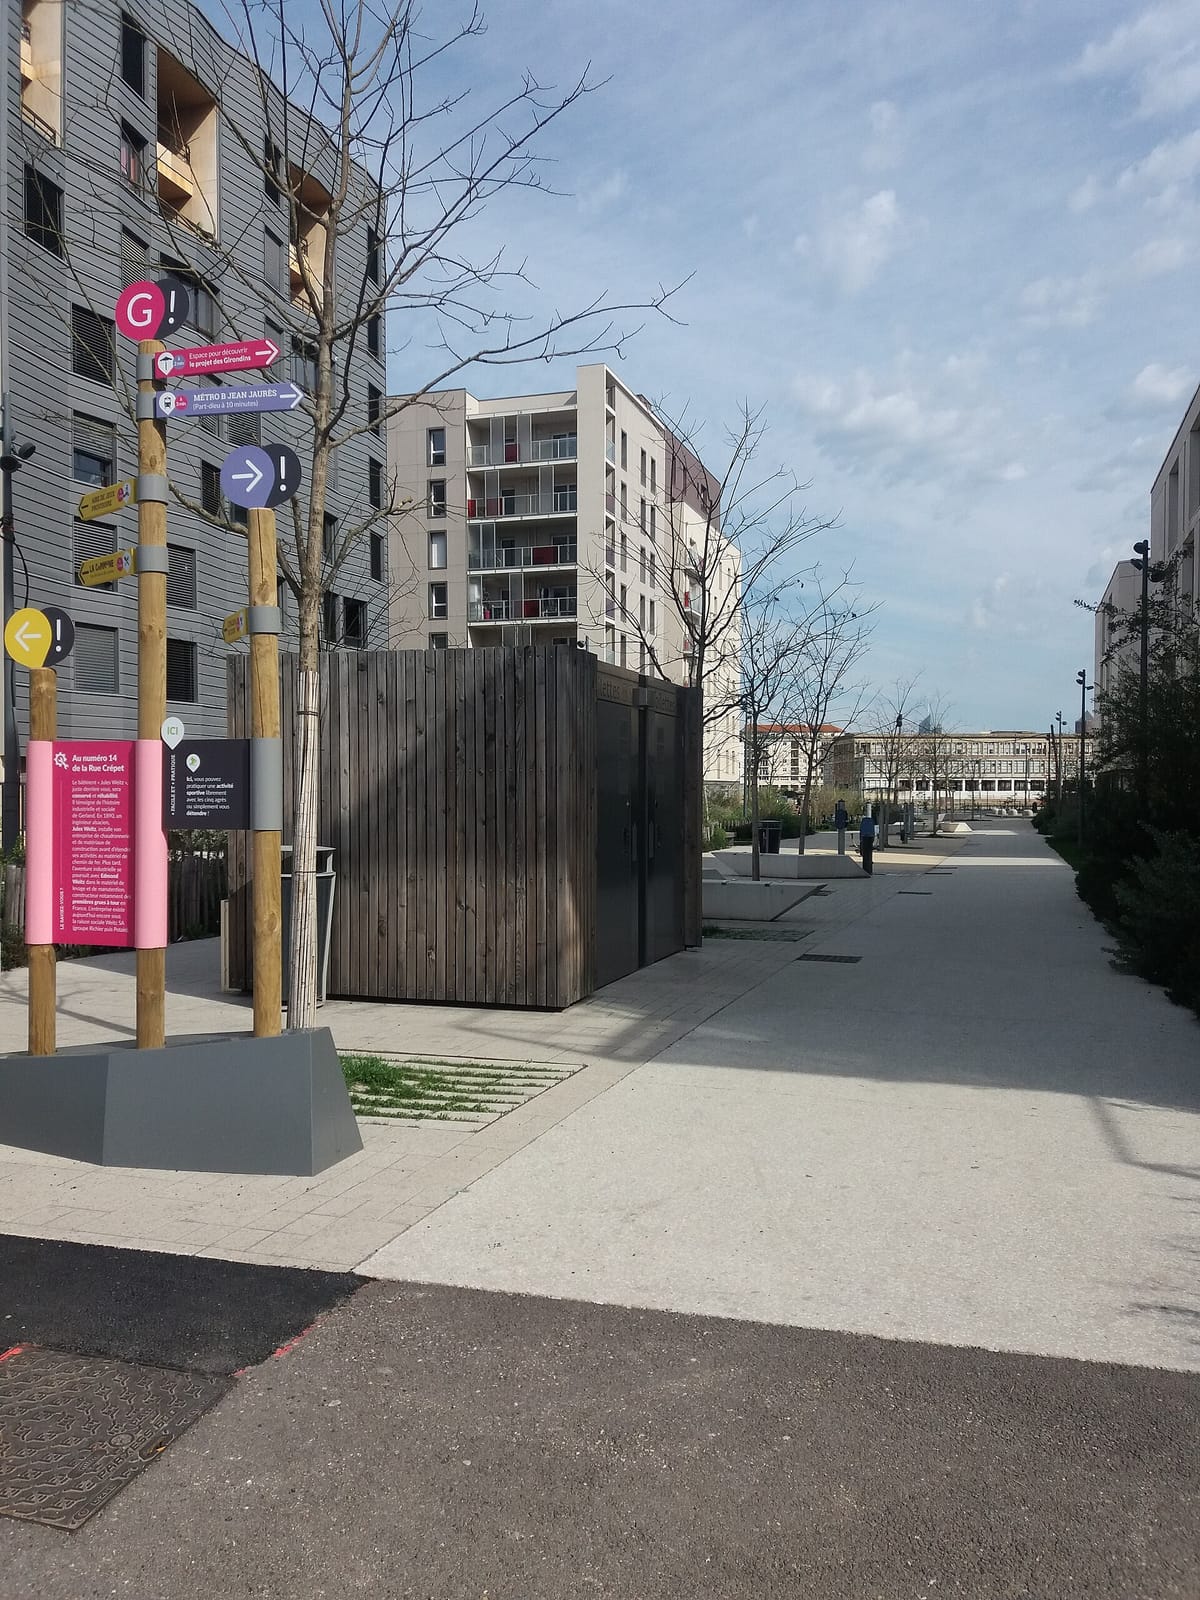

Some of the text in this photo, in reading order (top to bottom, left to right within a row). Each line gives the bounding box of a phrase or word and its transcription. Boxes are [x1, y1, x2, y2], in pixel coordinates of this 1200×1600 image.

[127, 292, 152, 326] G
[168, 290, 176, 324] !
[188, 347, 248, 360] Espace pour découvrir
[195, 359, 212, 368] projet
[213, 358, 223, 366] des
[223, 355, 251, 364] Girondins
[193, 391, 220, 402] MÉTRO
[227, 390, 248, 400] JEAN
[248, 388, 278, 398] JAURÈS
[192, 402, 220, 411] (Part-dieu
[234, 400, 259, 409] minutes)
[167, 726, 178, 735] ICI
[72, 754, 117, 762] Au numéro 14
[102, 764, 124, 773] Crépet
